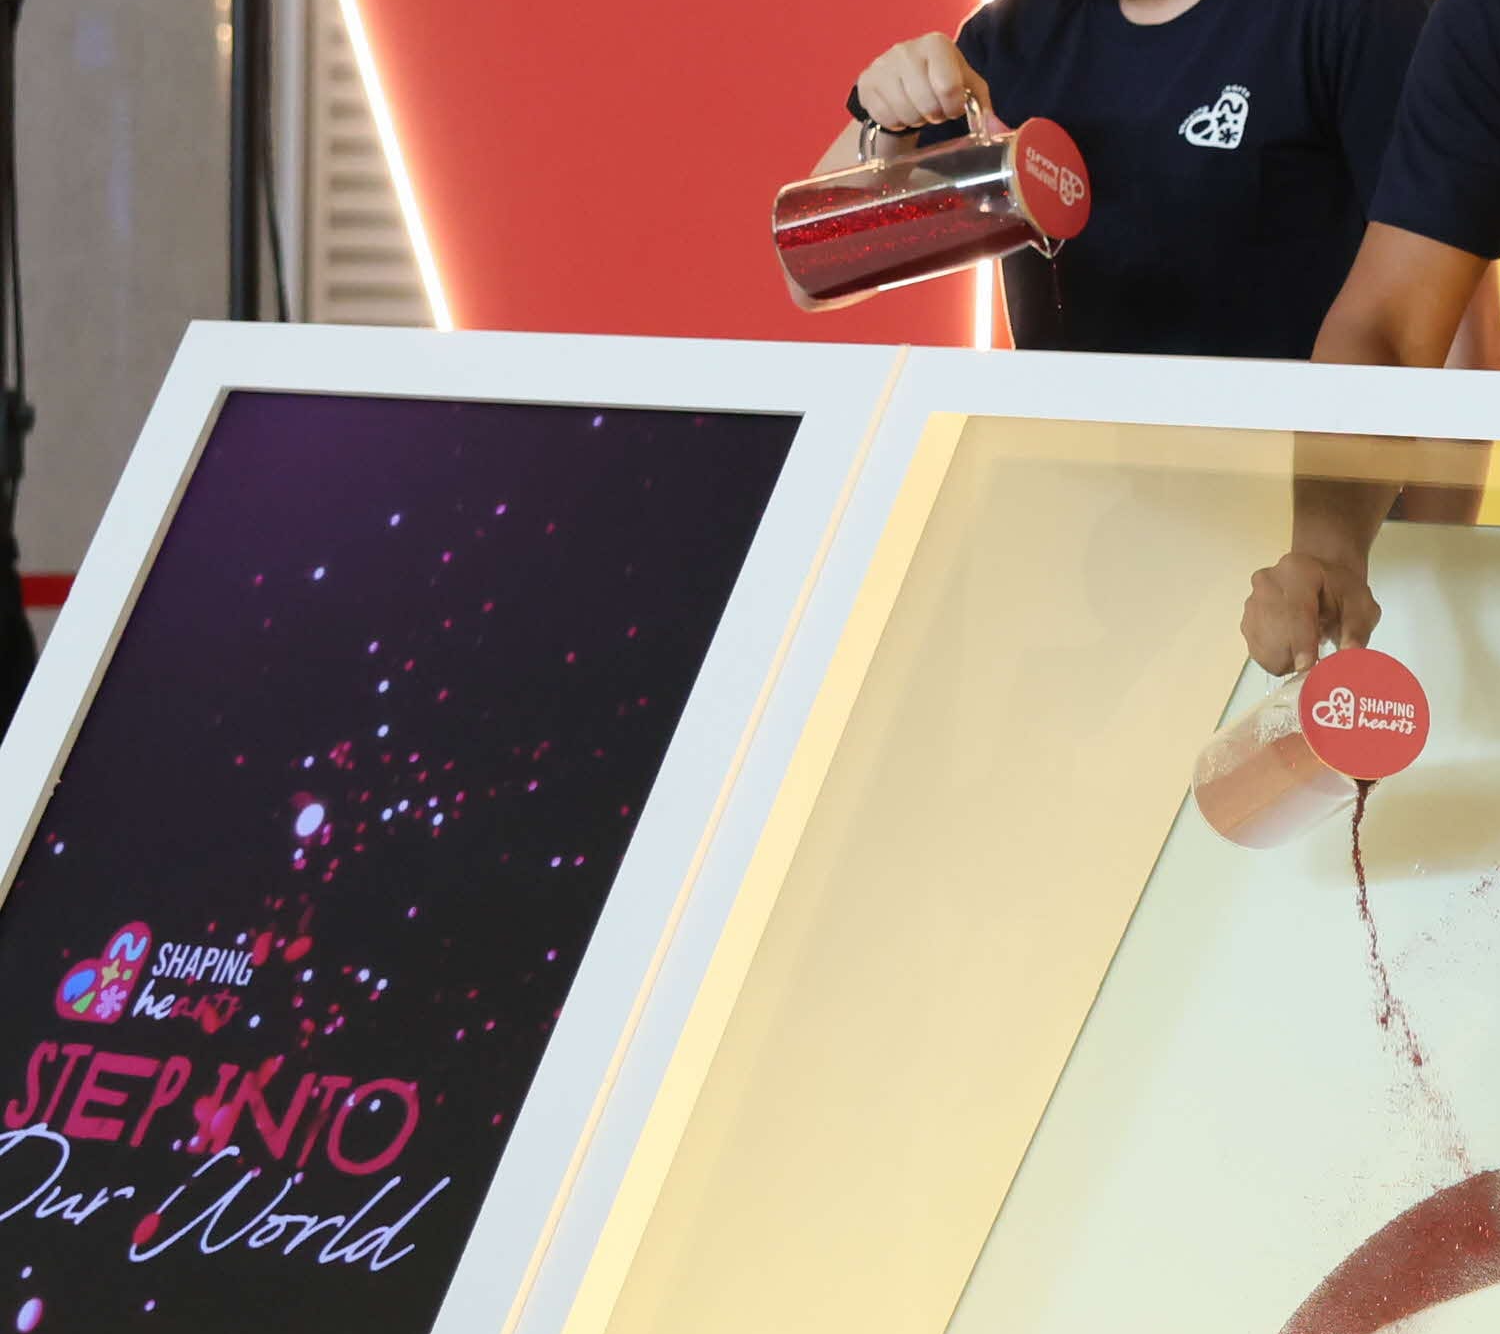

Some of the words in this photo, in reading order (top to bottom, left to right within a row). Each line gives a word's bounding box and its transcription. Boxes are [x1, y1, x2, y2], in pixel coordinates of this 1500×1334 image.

[1357, 715, 1417, 736] hearts
[1359, 696, 1415, 719] SHAPING
[151, 941, 254, 986] SHAPING
[4, 1040, 193, 1148] STEP
[186, 1062, 421, 1176] INTO
[128, 1145, 451, 1271] World
